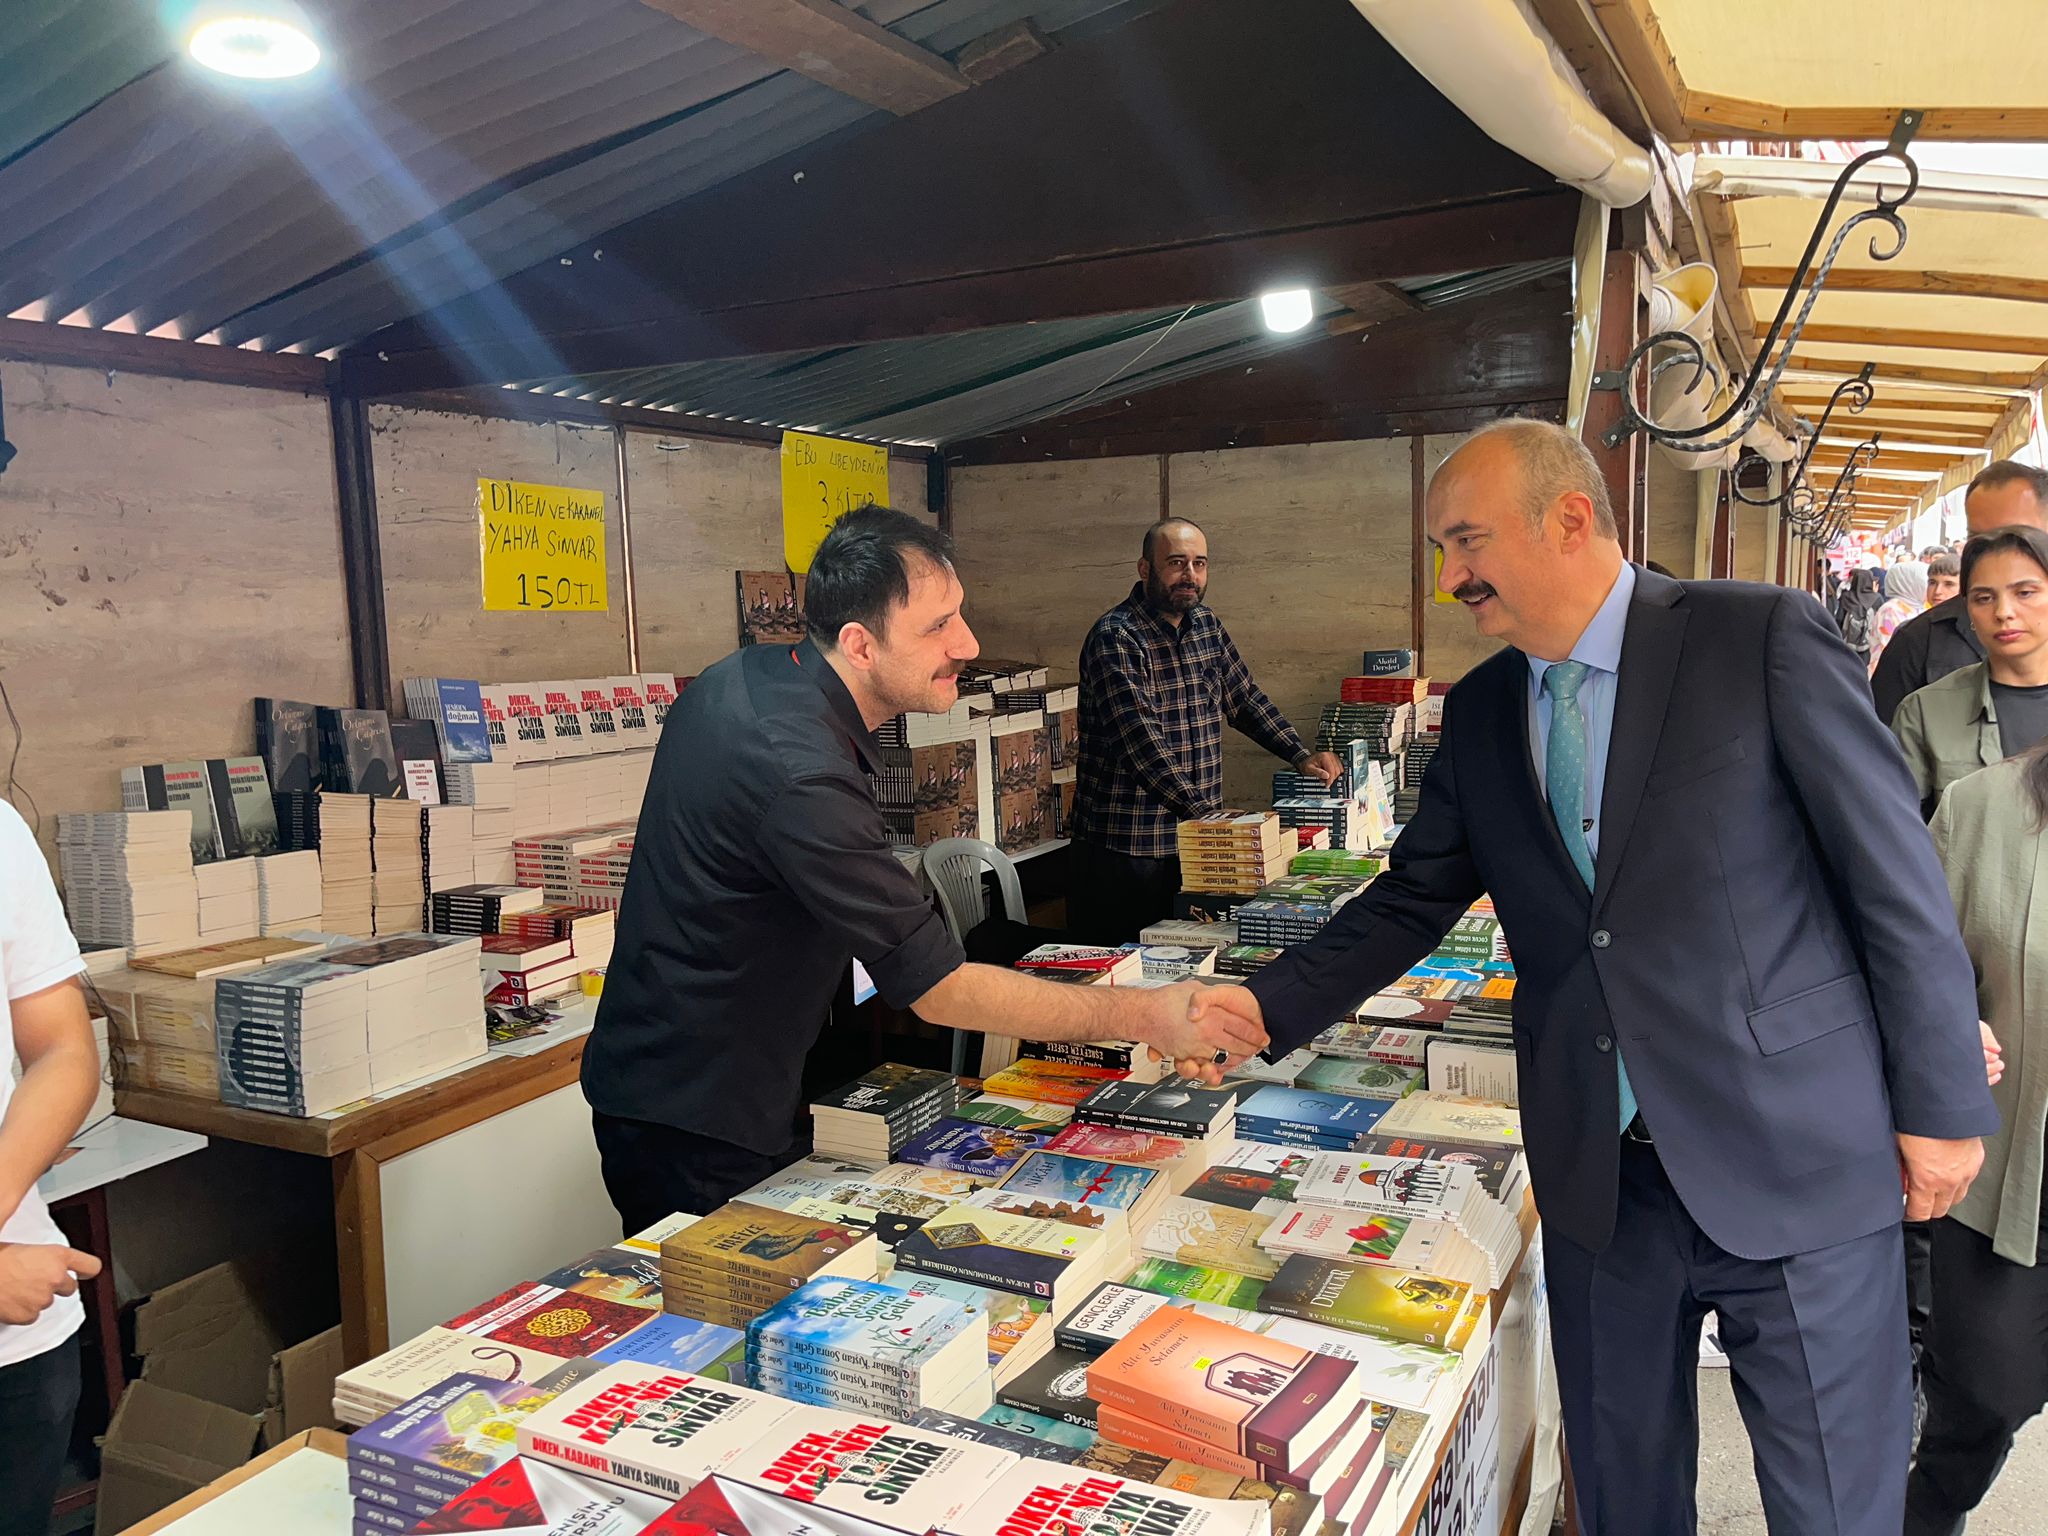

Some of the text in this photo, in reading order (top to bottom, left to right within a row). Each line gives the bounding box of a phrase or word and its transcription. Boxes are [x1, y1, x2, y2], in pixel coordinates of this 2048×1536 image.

[818, 480, 830, 518] 3
[489, 522, 540, 554] YAHYA
[448, 711, 478, 722] doğmak
[1332, 1164, 1352, 1184] BOYKOT
[958, 1268, 1003, 1284] TOPLUMUNUN
[1006, 1278, 1031, 1288] KUR'AN
[1310, 1268, 1354, 1308] DUALAR
[804, 1284, 860, 1319] Bahar
[854, 1294, 898, 1322] Sonra
[880, 1298, 916, 1322] Gelir
[1074, 1286, 1124, 1330] GENÇLERLE
[1097, 1293, 1144, 1332] HASBİHAL
[794, 1341, 814, 1356] Gelir
[816, 1349, 840, 1362] Sonra
[792, 1360, 813, 1374] Gelir
[842, 1354, 870, 1370] Kıştan
[872, 1361, 898, 1376] Bahar
[1118, 1352, 1140, 1374] Aile
[814, 1367, 838, 1381] Sonra
[840, 1373, 869, 1388] Kıştan
[1065, 1370, 1087, 1392] KISKA
[793, 1380, 814, 1394] Gelir
[815, 1386, 840, 1402] Sonra
[870, 1379, 900, 1397] Bahar
[380, 1381, 477, 1438] Susayan Gönüller
[841, 1392, 870, 1410] Kıştan
[872, 1400, 900, 1417] Bahar
[610, 1460, 642, 1484] YAHYA
